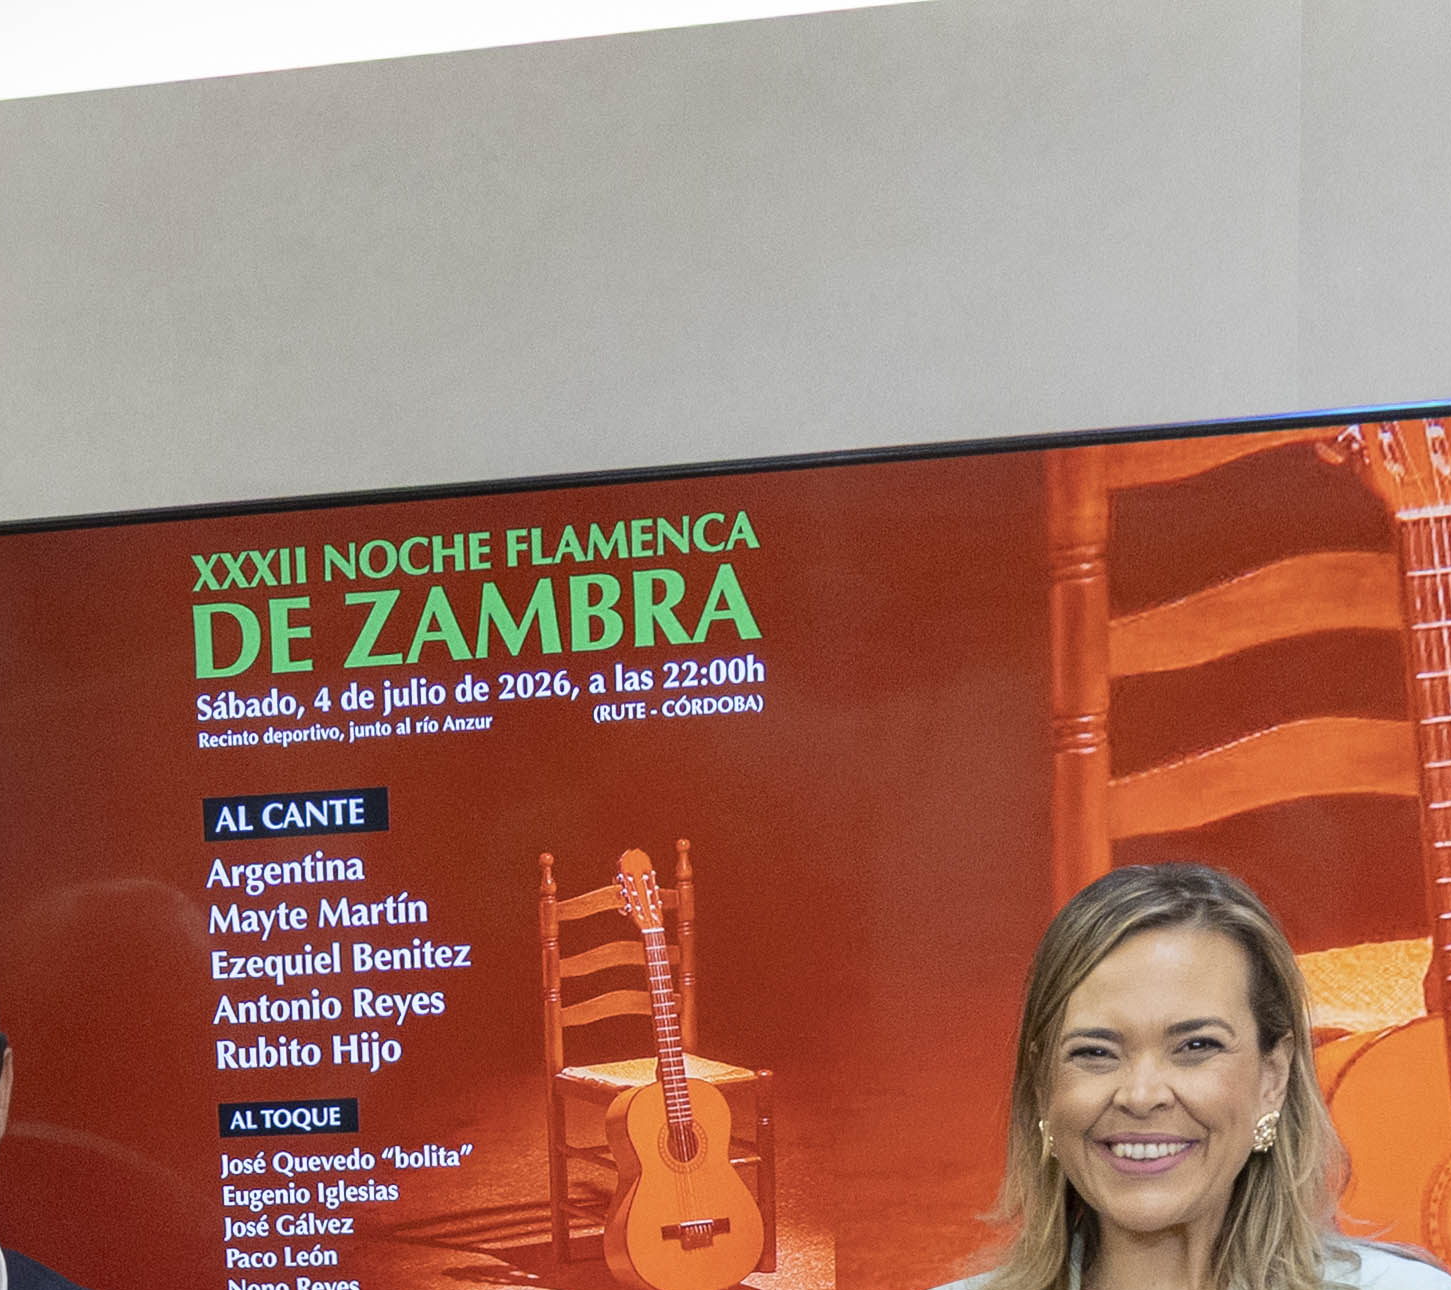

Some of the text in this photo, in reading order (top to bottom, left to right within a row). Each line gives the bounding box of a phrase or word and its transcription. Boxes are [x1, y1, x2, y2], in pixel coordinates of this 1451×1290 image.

[192, 511, 761, 592] XXXII NOCHE FLAMENCA
[193, 563, 762, 679] DE ZAMBRA
[196, 654, 766, 721] Sábado, 4 de julio de 2026, a las 22:00h
[592, 700, 646, 724] (RUTE
[662, 694, 764, 720] CÓRDOBA)
[198, 713, 493, 748] Recinto deportivo, junto al río Anzur
[215, 798, 365, 832] AL CANTE
[206, 850, 365, 896] Argentina
[208, 891, 428, 941] Mayte Martín
[211, 938, 472, 986] Ezequiel Benitez
[212, 987, 445, 1026] Antonio Reyes
[216, 1032, 402, 1073] Rubito Hijo
[230, 1106, 341, 1131] AL TOQUE
[220, 1152, 266, 1178] José
[272, 1148, 375, 1177] Quevedo
[222, 1179, 399, 1212] Eugenio Iglesias
[224, 1212, 354, 1241] José Gálvez
[226, 1244, 338, 1269] Paco León
